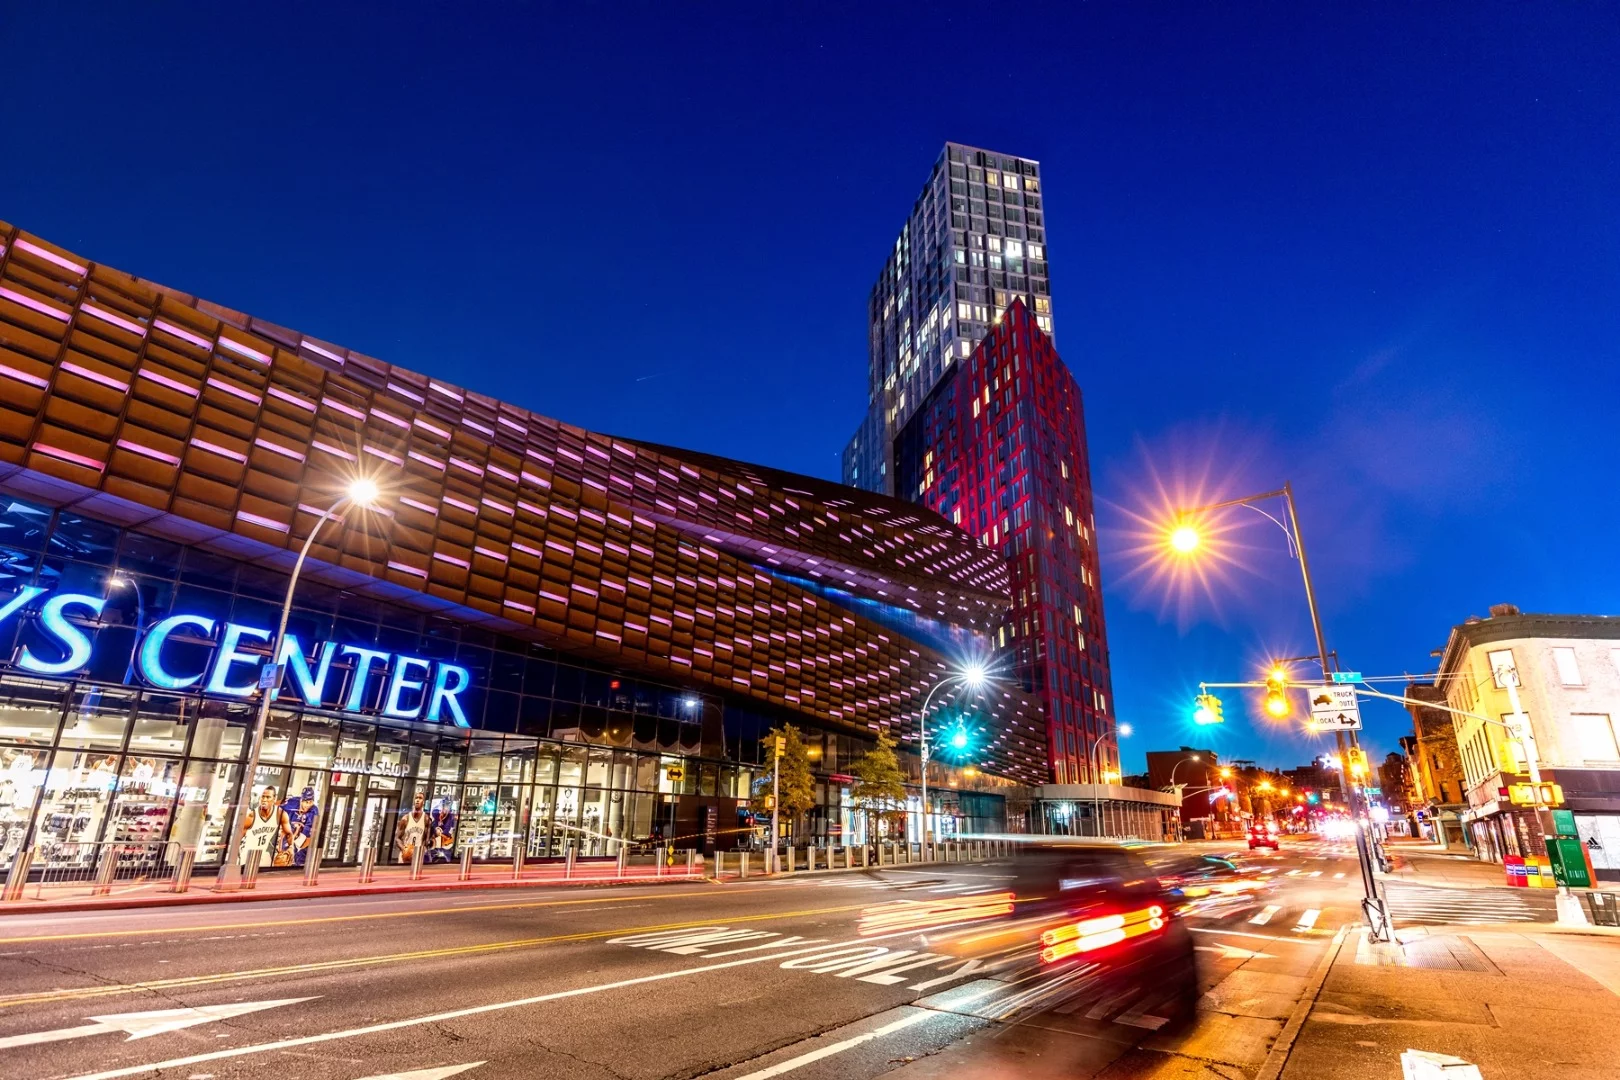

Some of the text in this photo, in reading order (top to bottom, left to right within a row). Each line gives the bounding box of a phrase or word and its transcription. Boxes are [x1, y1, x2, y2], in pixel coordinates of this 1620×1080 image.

[138, 613, 471, 728] CENTER
[269, 767, 283, 776] PLAY
[331, 756, 410, 777] SWAG SHOP
[467, 787, 478, 797] TO
[257, 835, 267, 847] 15
[605, 926, 831, 958] ONLY
[778, 946, 984, 991] ONLY
